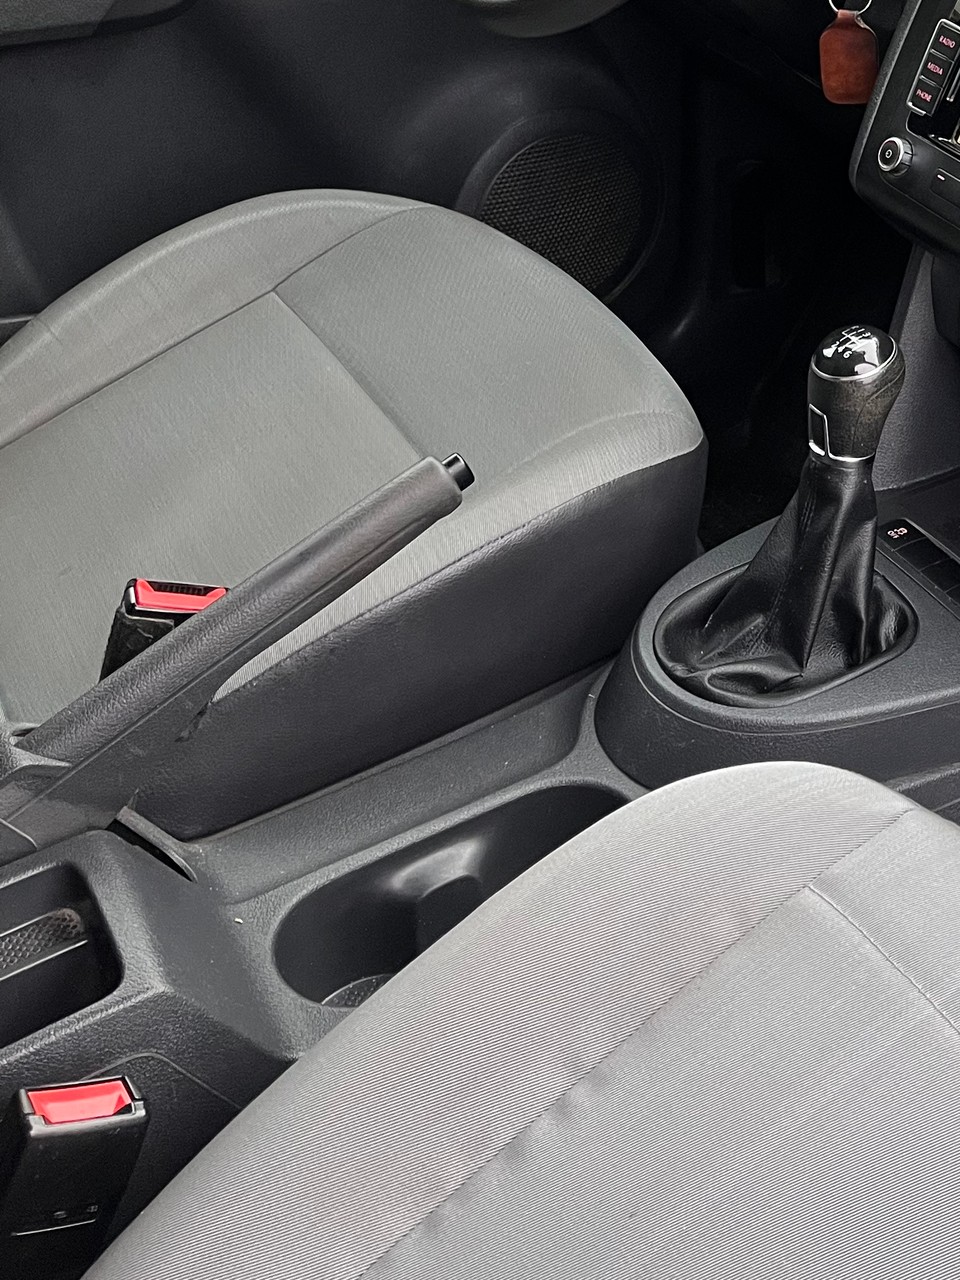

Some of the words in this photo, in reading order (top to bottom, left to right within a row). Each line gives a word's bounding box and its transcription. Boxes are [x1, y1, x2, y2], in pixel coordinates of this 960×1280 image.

[939, 35, 956, 49] RADIO
[927, 61, 944, 75] MEDIA
[915, 88, 933, 102] PHONE
[843, 350, 852, 359] 6
